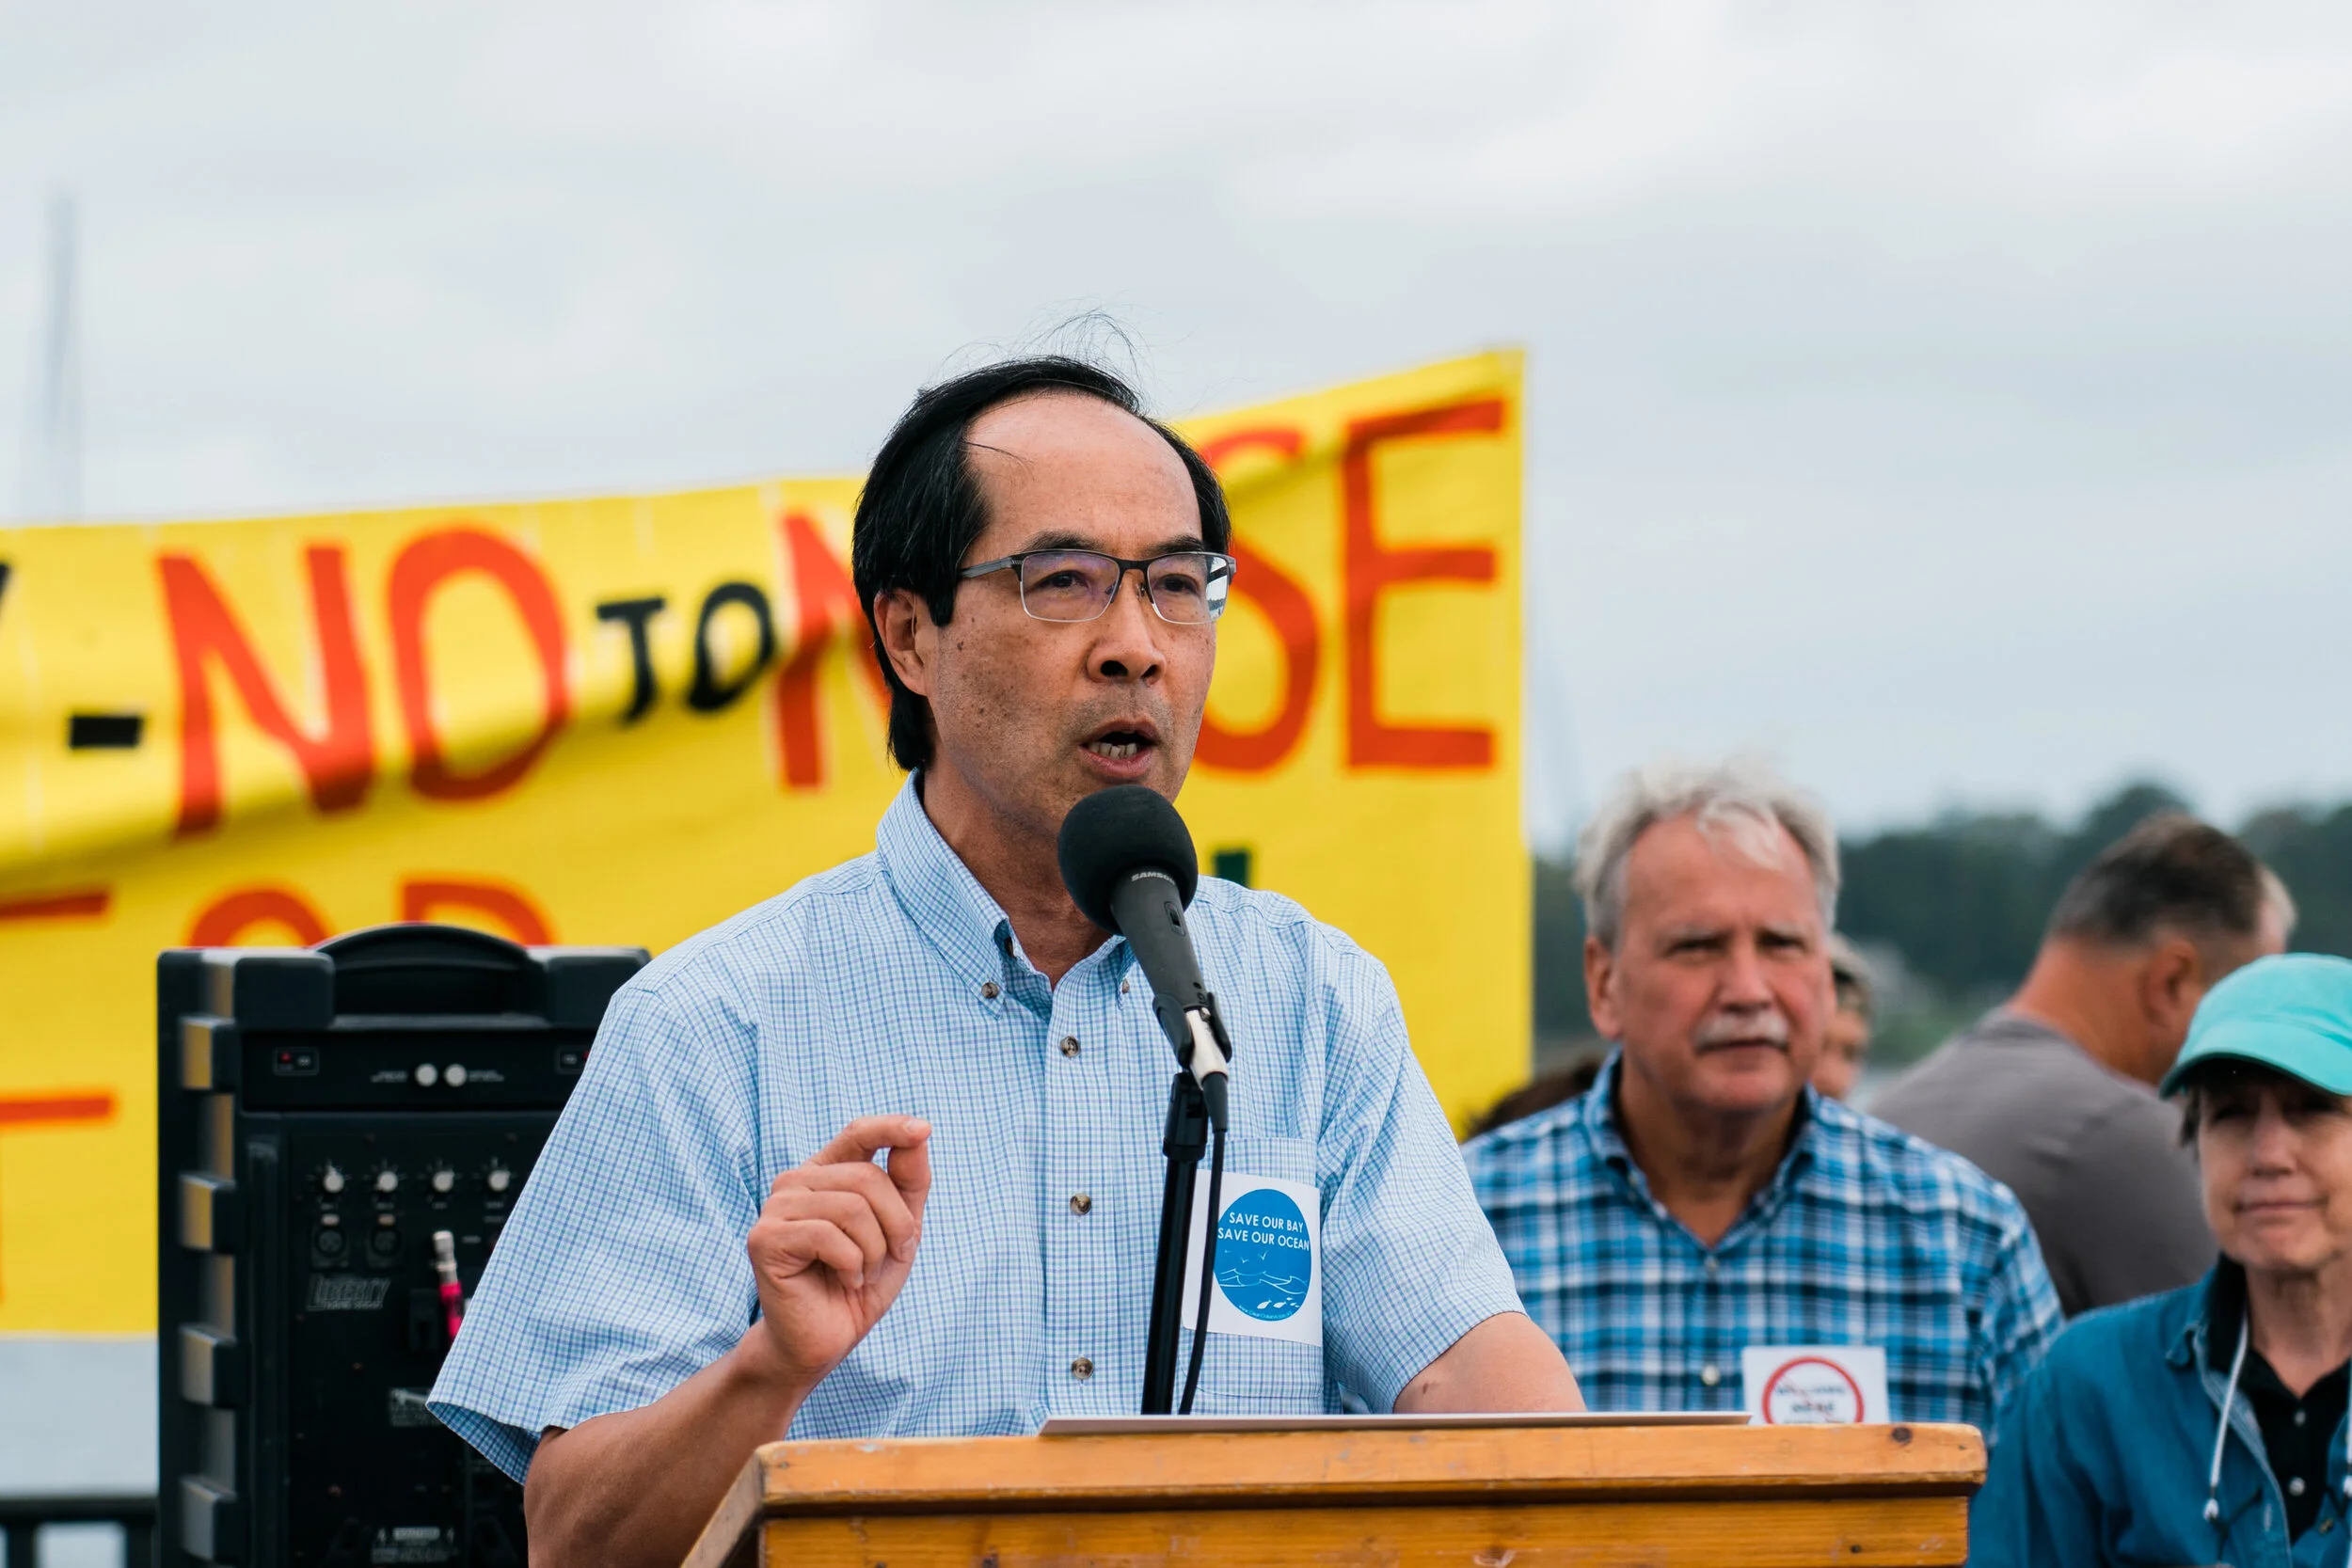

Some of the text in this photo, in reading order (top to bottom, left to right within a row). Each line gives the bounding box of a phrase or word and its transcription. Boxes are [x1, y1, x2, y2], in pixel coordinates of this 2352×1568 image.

[155, 520, 572, 837] NO
[595, 581, 775, 724] TO
[777, 395, 1506, 788] NSE
[1131, 871, 1176, 885] SAMSON
[1229, 1212, 1304, 1234] SAVE OUR BAY
[1217, 1227, 1310, 1252] SAVE OUR OCEAN
